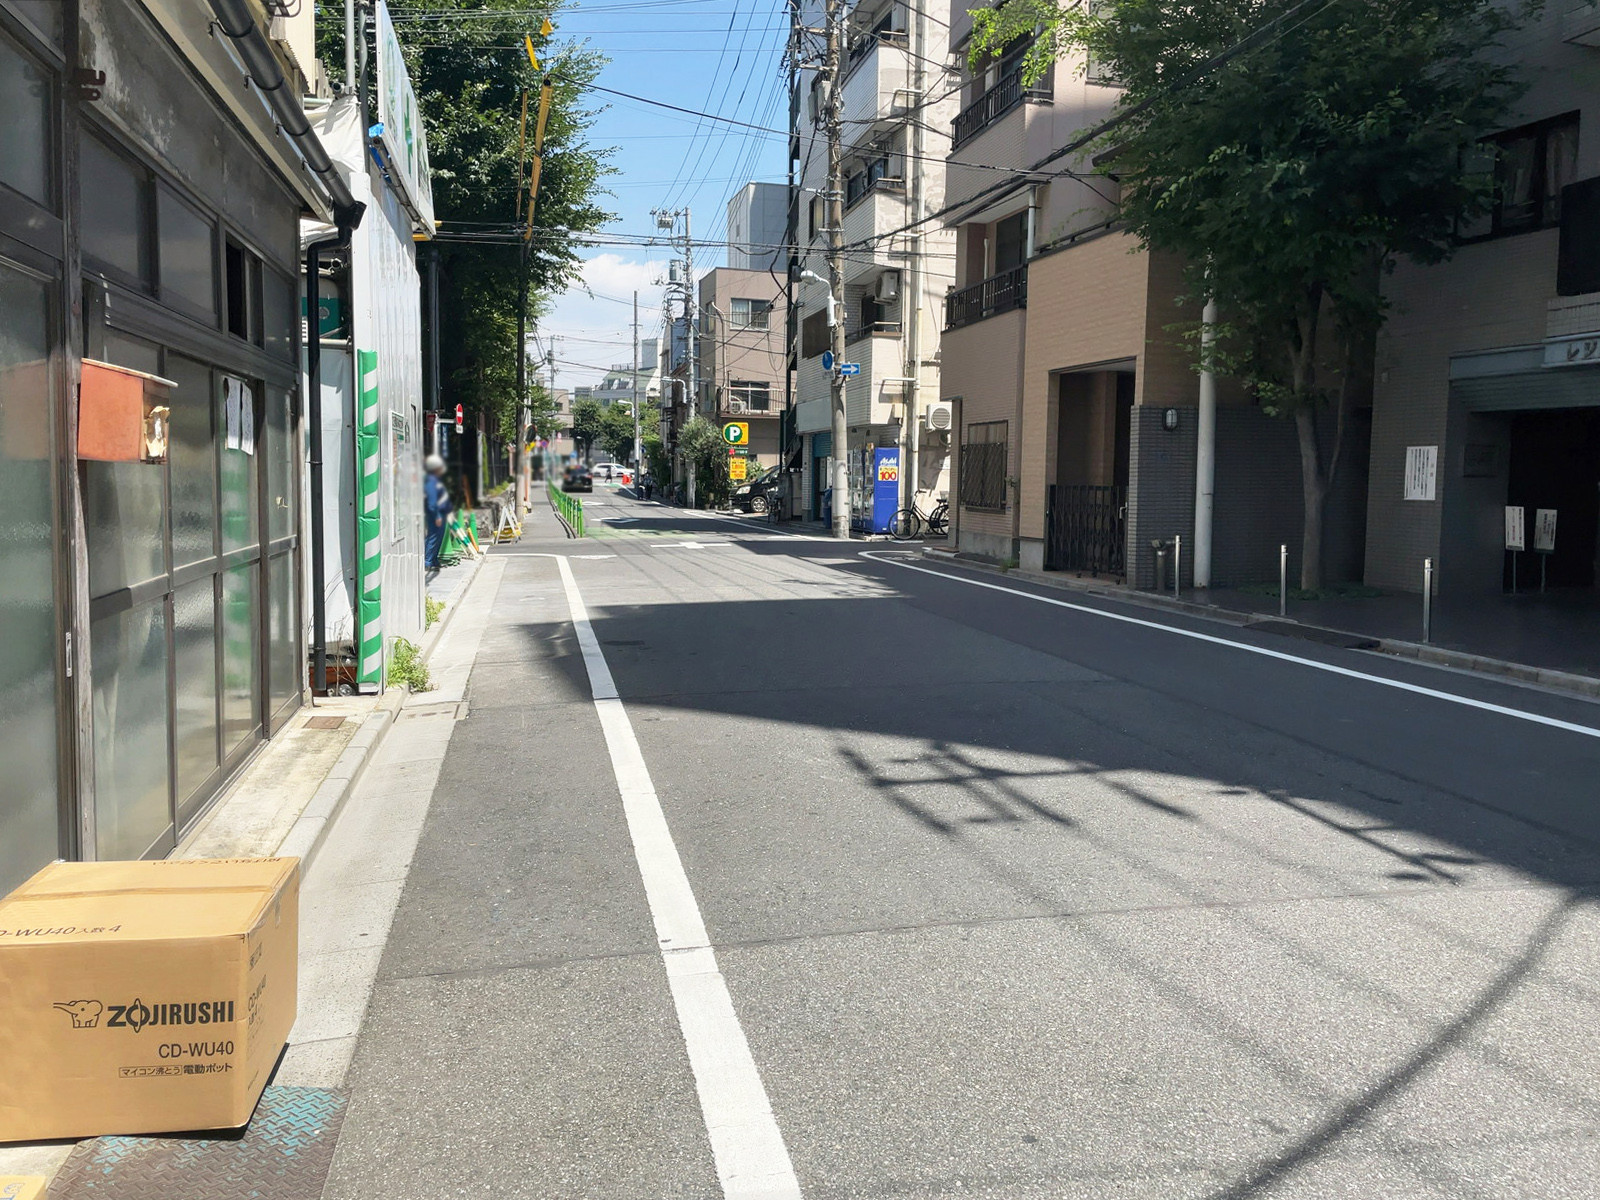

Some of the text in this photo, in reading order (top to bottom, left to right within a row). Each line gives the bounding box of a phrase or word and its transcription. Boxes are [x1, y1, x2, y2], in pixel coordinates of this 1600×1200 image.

[729, 426, 741, 441] P
[880, 471, 897, 481] 100
[107, 997, 234, 1034] ZOJIRUSHI
[158, 1040, 235, 1059] CD-WU40
[121, 1065, 181, 1077] マイコン沸とう
